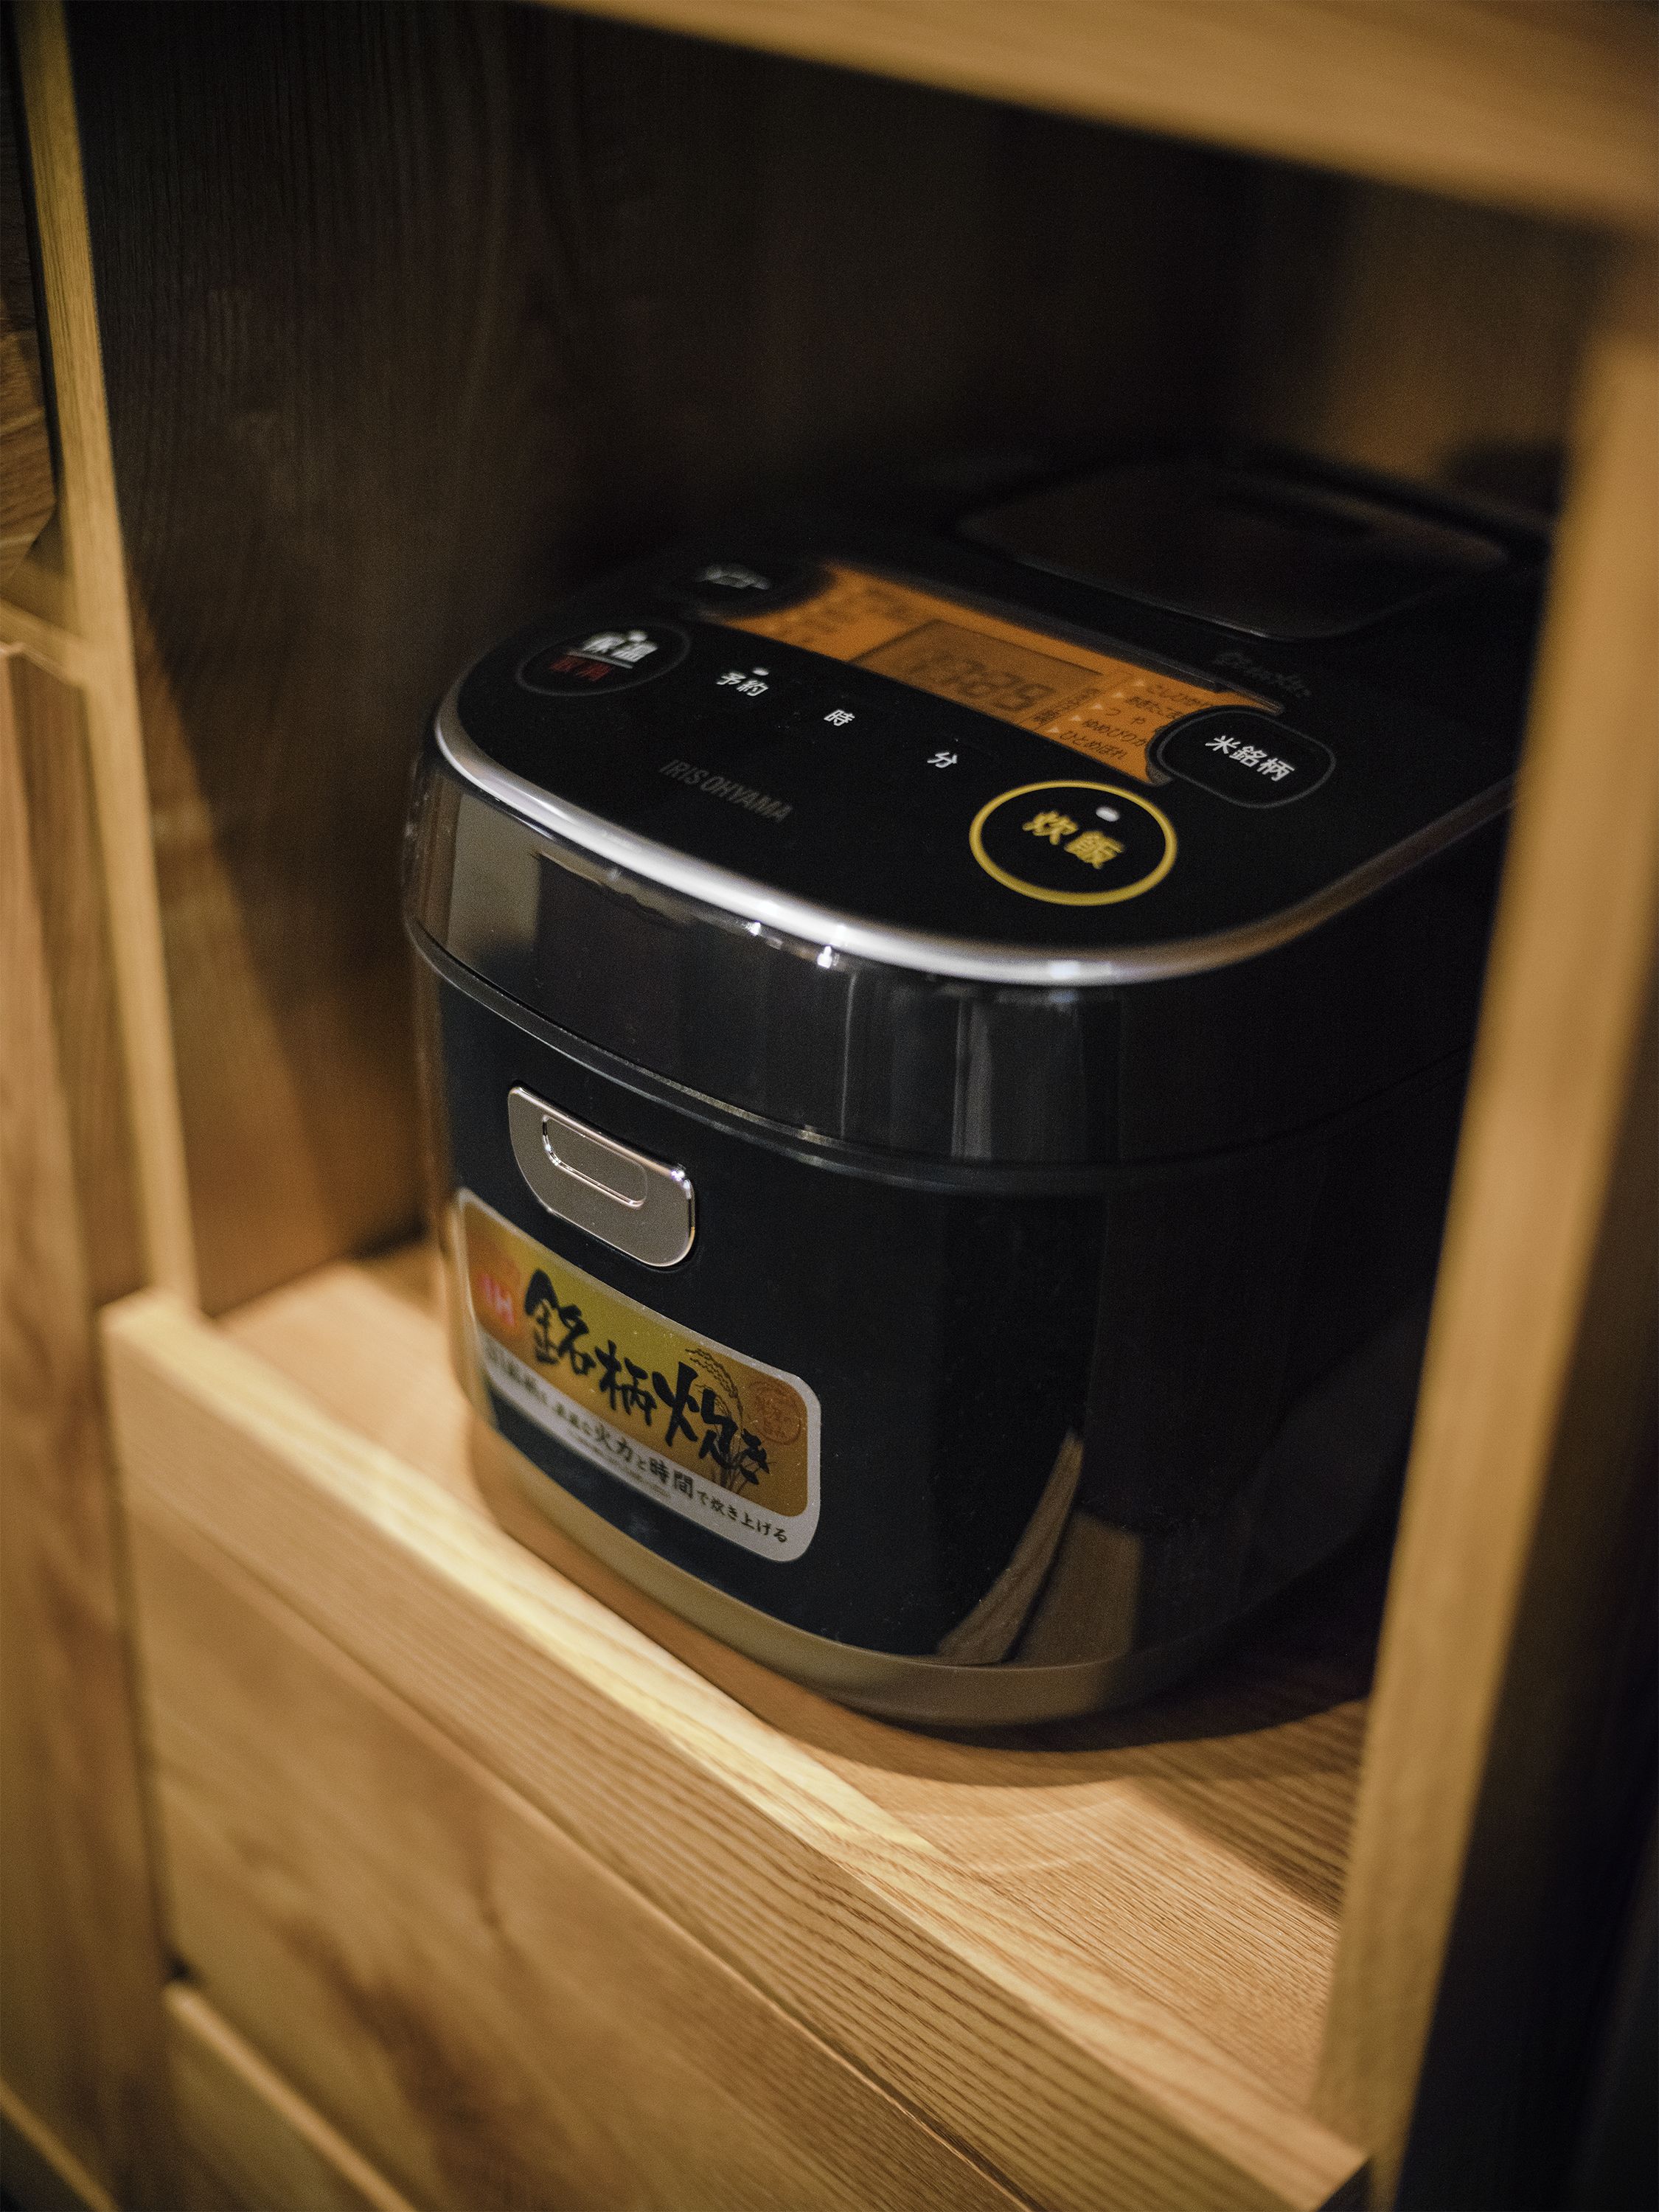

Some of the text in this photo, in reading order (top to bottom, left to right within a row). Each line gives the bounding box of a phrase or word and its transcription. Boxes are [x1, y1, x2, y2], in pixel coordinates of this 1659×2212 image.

[716, 670, 769, 697] 予約
[824, 708, 856, 727] 時
[927, 751, 958, 769] 分
[1205, 734, 1295, 782] 米銘柄
[660, 759, 793, 824] IRIS OHYAMA
[1022, 810, 1125, 869] 炊飯
[524, 1268, 771, 1486] 銘柄炊き
